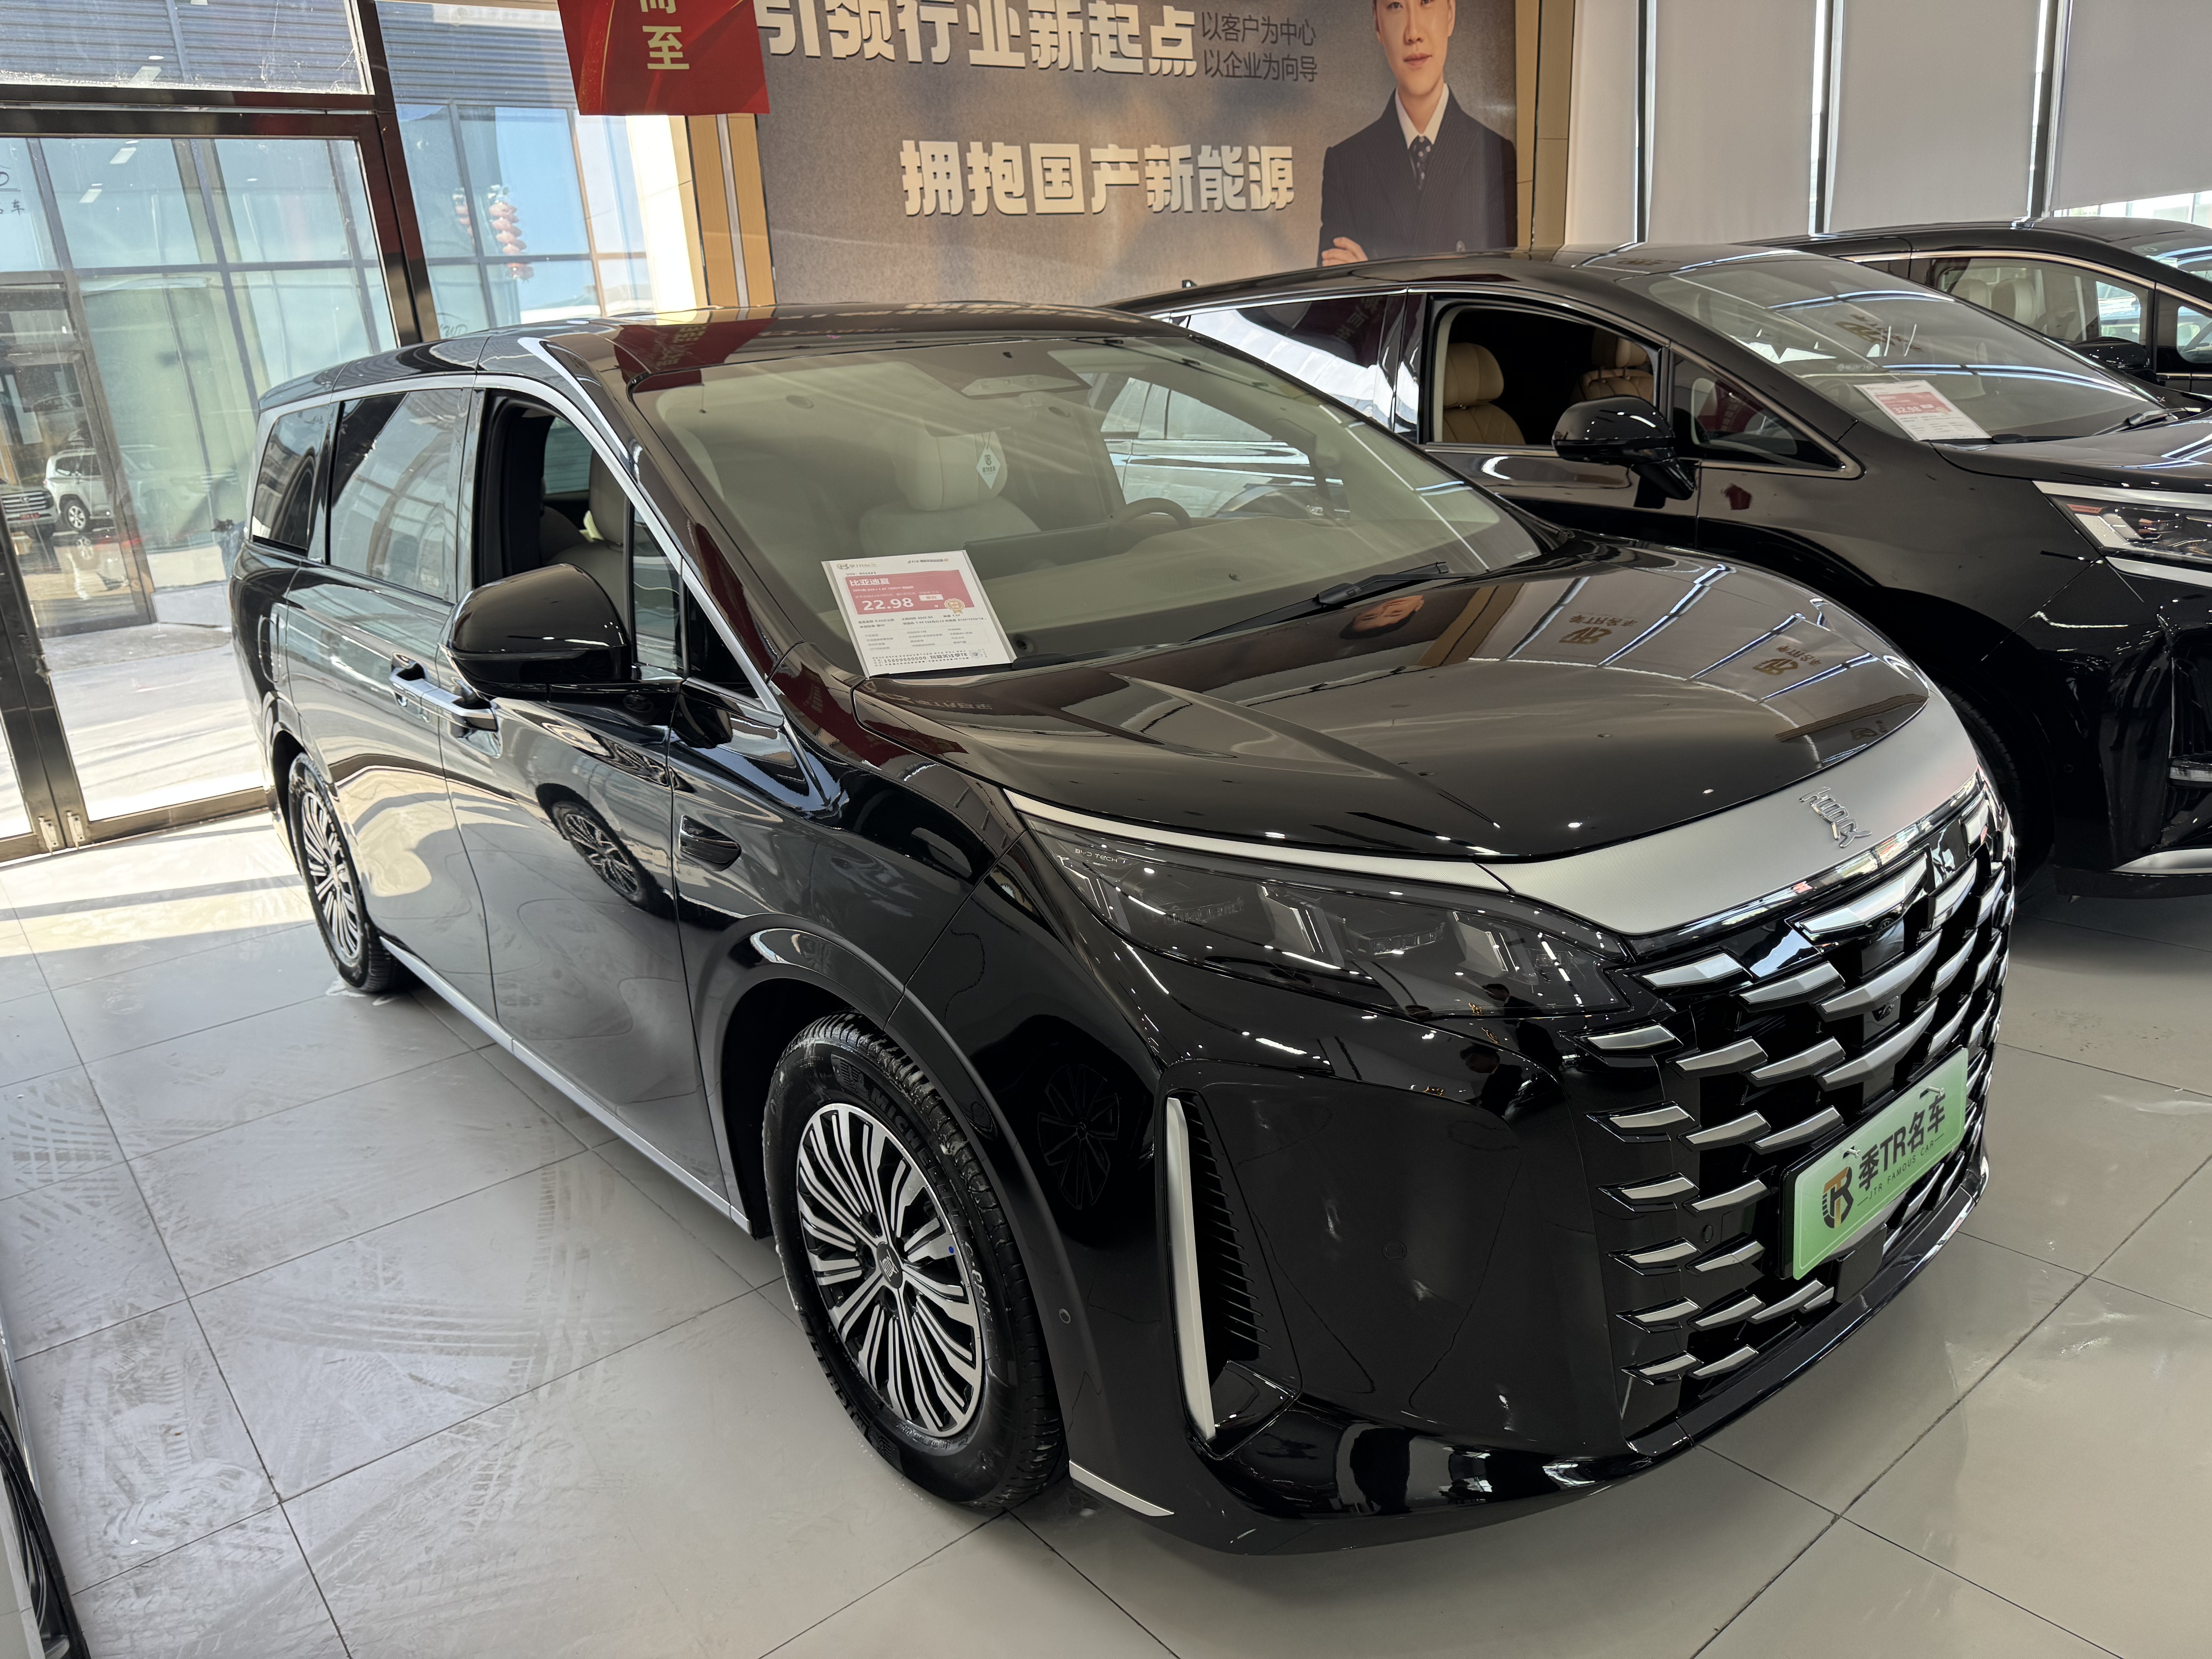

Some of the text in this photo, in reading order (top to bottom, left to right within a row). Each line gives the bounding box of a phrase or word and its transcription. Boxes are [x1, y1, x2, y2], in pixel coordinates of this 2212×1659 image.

[757, 0, 1197, 76] 引领行业新起点
[1201, 11, 1317, 46] 以客户为中心
[1203, 50, 1317, 82] 以企业为向导
[900, 140, 1295, 216] 拥抱国产新能源
[862, 597, 914, 611] 22.98
[1074, 848, 1092, 857] BYD
[1858, 1092, 1946, 1192] 季TR名车
[1887, 1154, 1916, 1184] FAMOUS
[1920, 1140, 1934, 1156] CAR
